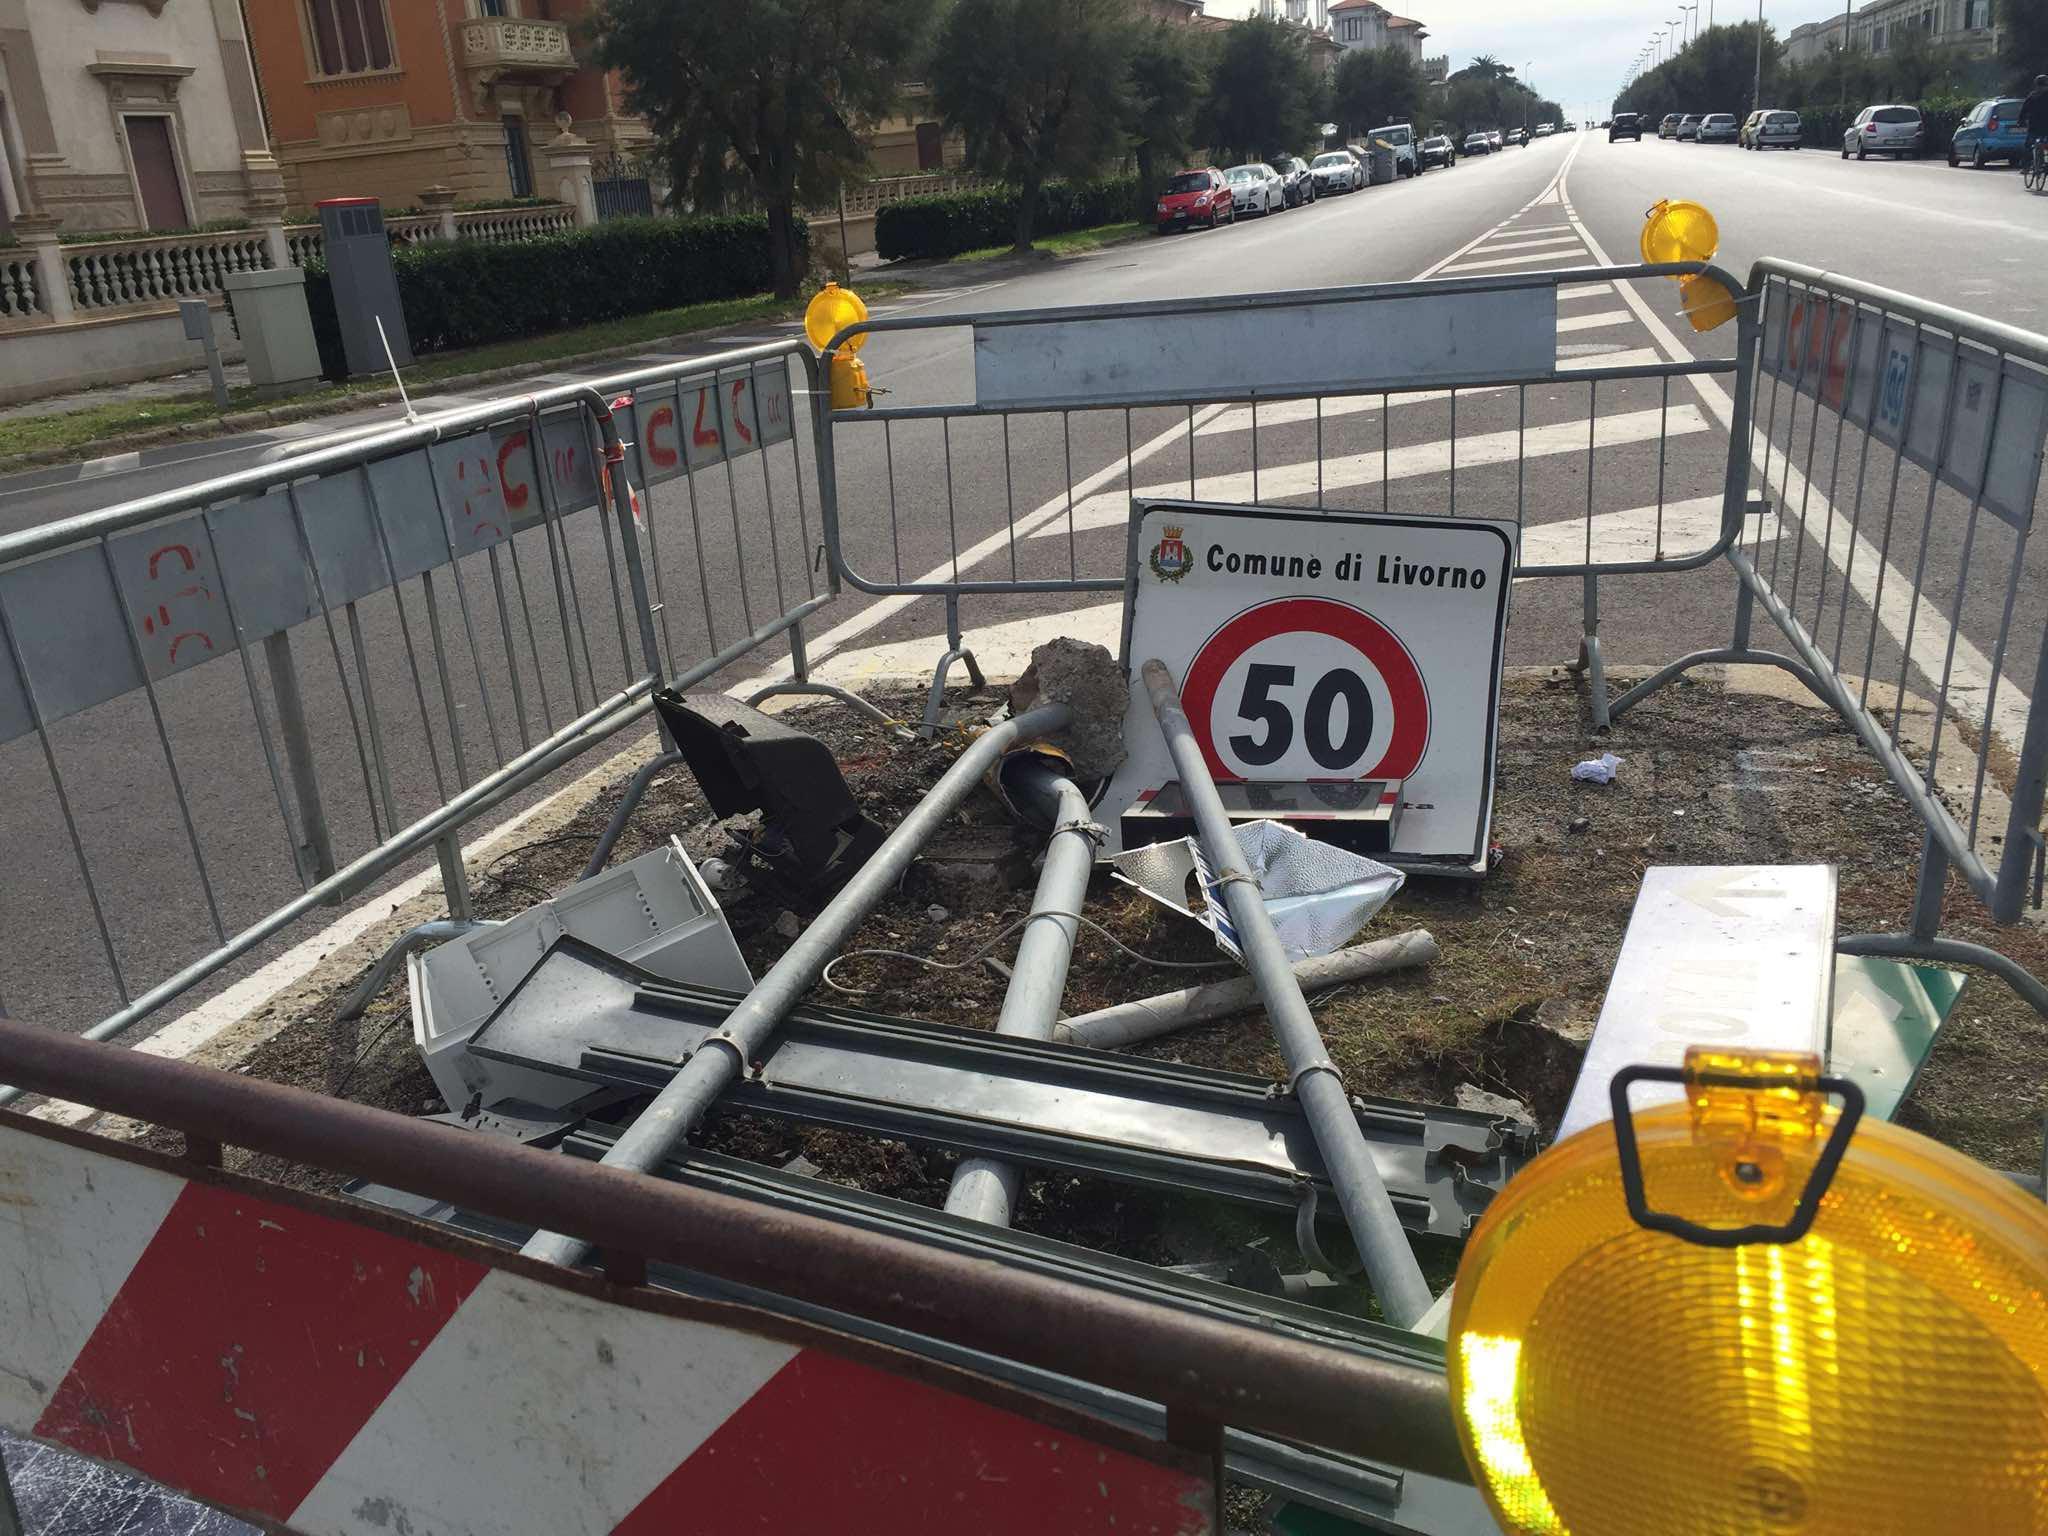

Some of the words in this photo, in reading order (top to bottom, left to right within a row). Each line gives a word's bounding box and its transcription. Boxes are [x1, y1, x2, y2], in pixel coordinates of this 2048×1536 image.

[1335, 552, 1363, 582] di
[1377, 554, 1487, 590] Livorno
[1229, 663, 1374, 770] 50
